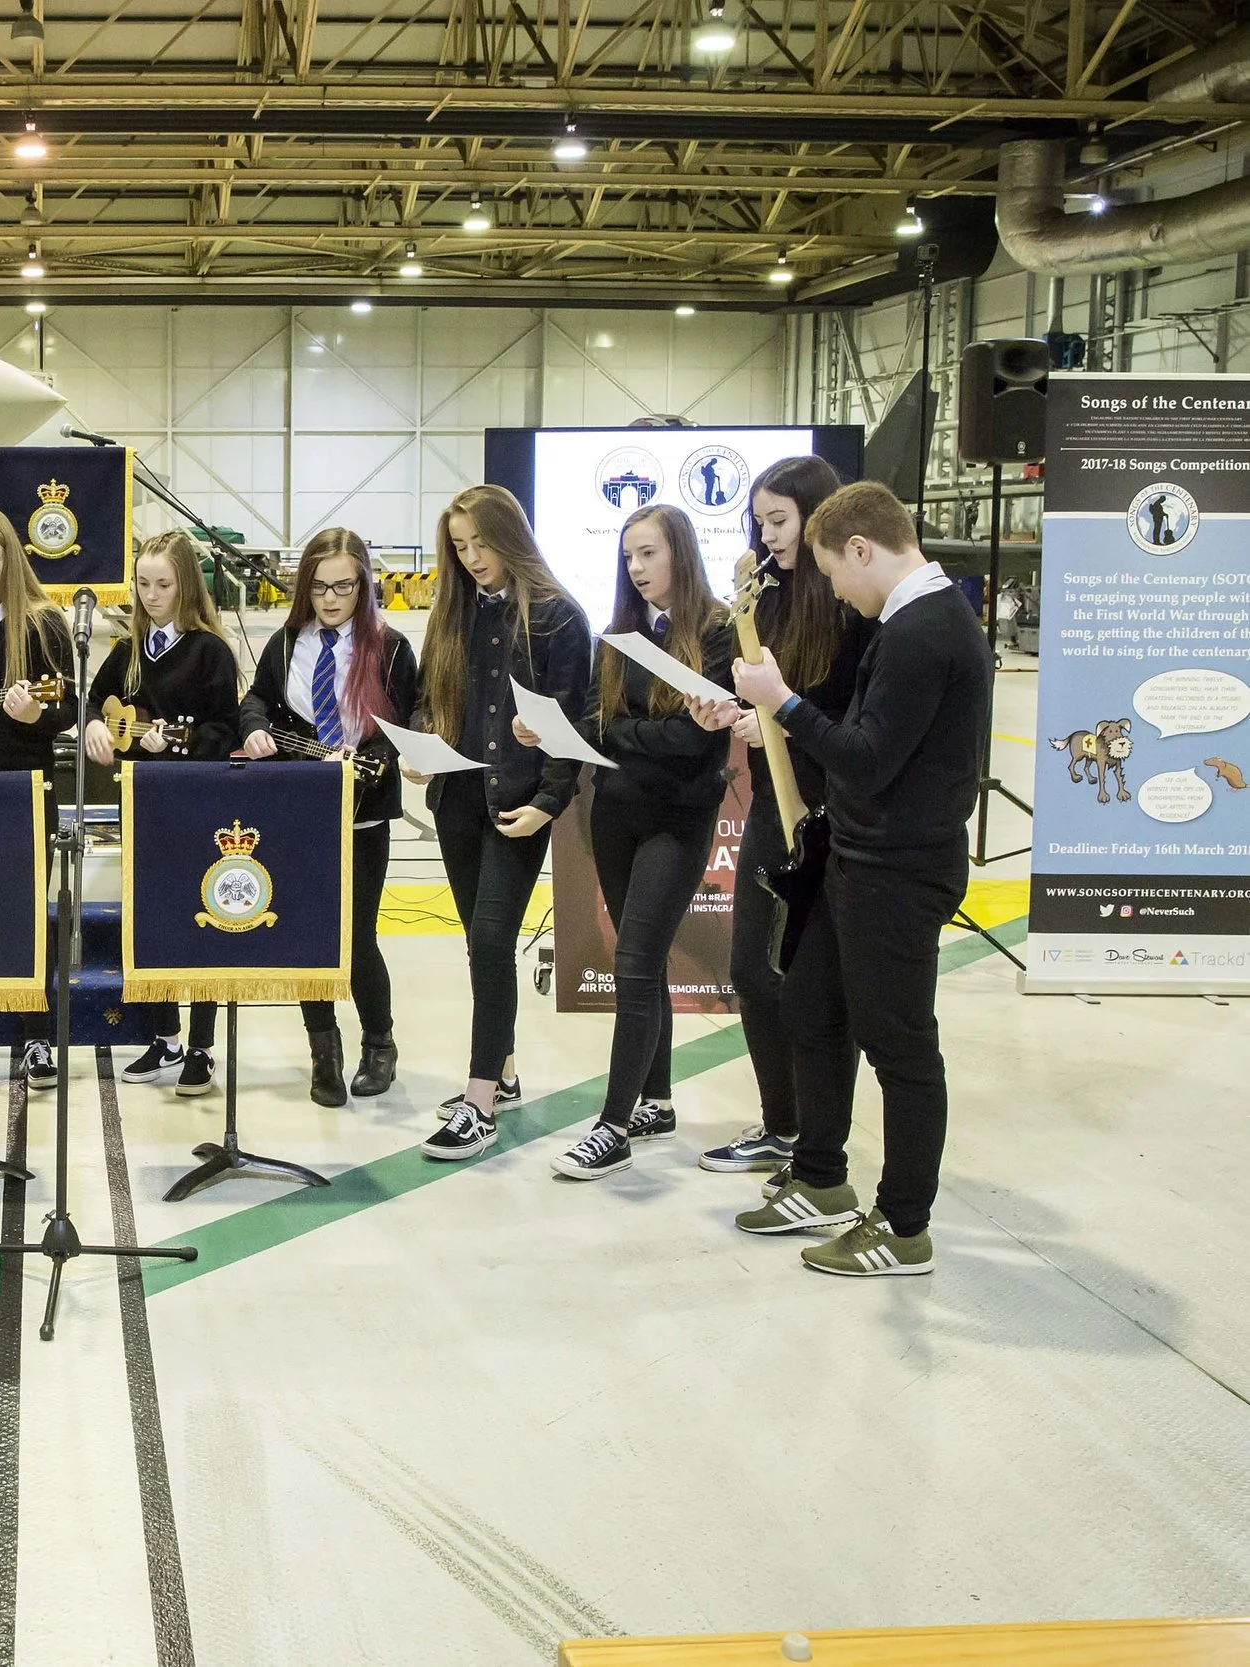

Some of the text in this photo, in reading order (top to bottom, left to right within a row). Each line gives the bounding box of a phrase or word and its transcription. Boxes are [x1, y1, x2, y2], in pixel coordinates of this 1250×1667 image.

[1081, 396, 1250, 412] Songs of the Centenar
[1081, 459, 1250, 474] 2017-18 Songs Competition
[1129, 500, 1141, 528] SONGS
[1166, 485, 1198, 529] CENTENARY
[1063, 572, 1102, 588] Songs
[1105, 572, 1119, 584] of
[1121, 572, 1140, 585] the
[1144, 573, 1209, 588] Centenary
[1065, 591, 1250, 606] is engaging young people wit
[1073, 609, 1249, 624] the First World War through
[1060, 628, 1095, 642] song,
[1097, 627, 1140, 642] getting
[1143, 628, 1163, 639] the
[1166, 628, 1220, 639] children
[1224, 627, 1238, 639] of
[1062, 645, 1250, 661] world to sing for the centenary
[1049, 842, 1109, 855] Deadline:
[1112, 843, 1151, 858] Friday
[1155, 843, 1181, 855] 16th
[1184, 844, 1225, 856] March
[693, 904, 735, 913] INSTAGRA
[1139, 907, 1195, 916] @NeverSuch
[1105, 949, 1131, 962] Dave
[1131, 948, 1165, 962] Stewart
[1191, 951, 1246, 967] Trackd
[578, 983, 597, 993] AIR
